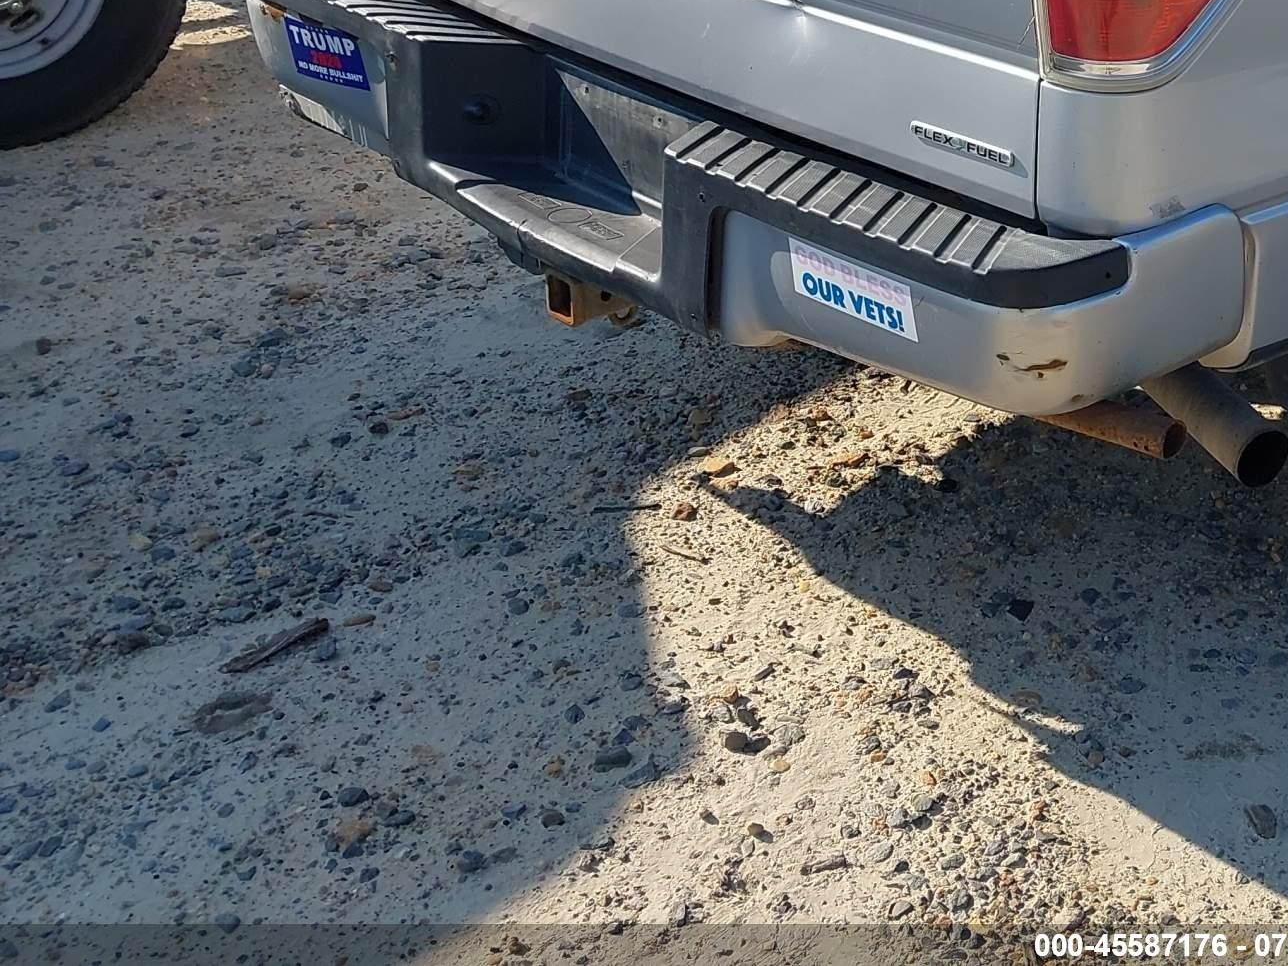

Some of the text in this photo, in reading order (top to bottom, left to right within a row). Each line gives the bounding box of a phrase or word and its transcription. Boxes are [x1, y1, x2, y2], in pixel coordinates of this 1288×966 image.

[289, 24, 355, 57] TRUMP
[298, 60, 364, 83] NO MORE BULLSHIT
[914, 124, 1008, 164] FLEX FUEL
[795, 245, 907, 305] GOD BLESS
[802, 271, 906, 333] OUR VETS!
